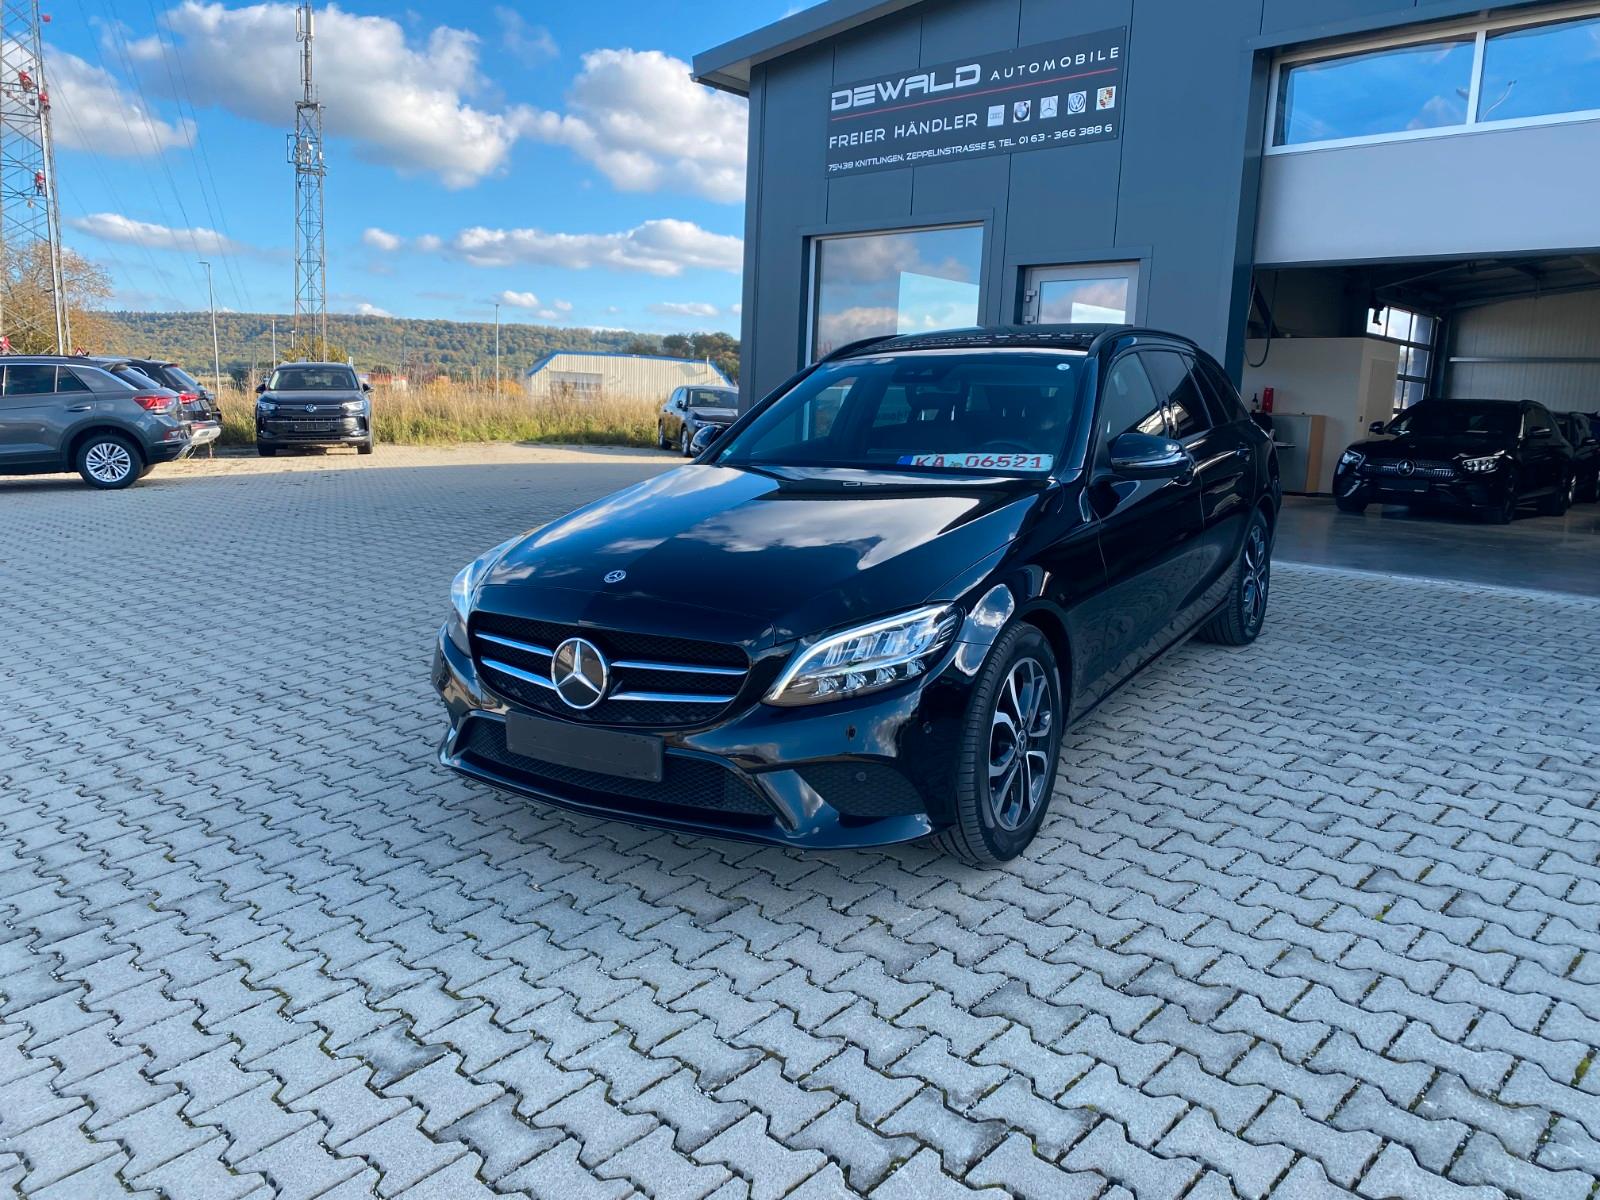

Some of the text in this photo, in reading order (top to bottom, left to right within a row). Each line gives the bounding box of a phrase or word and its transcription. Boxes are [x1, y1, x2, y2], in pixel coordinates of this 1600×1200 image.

[831, 46, 1120, 111] DEWALD AUTOMOBILE
[828, 112, 978, 149] FREIER HÄNDLER
[828, 161, 854, 172] 75438
[906, 141, 987, 160] ZEPPELINSTRASSE
[999, 138, 1017, 147] TEL.
[1054, 129, 1076, 140] 366
[1079, 125, 1102, 136] 388
[1104, 123, 1113, 133] 6
[916, 454, 1042, 469] KA 06521
